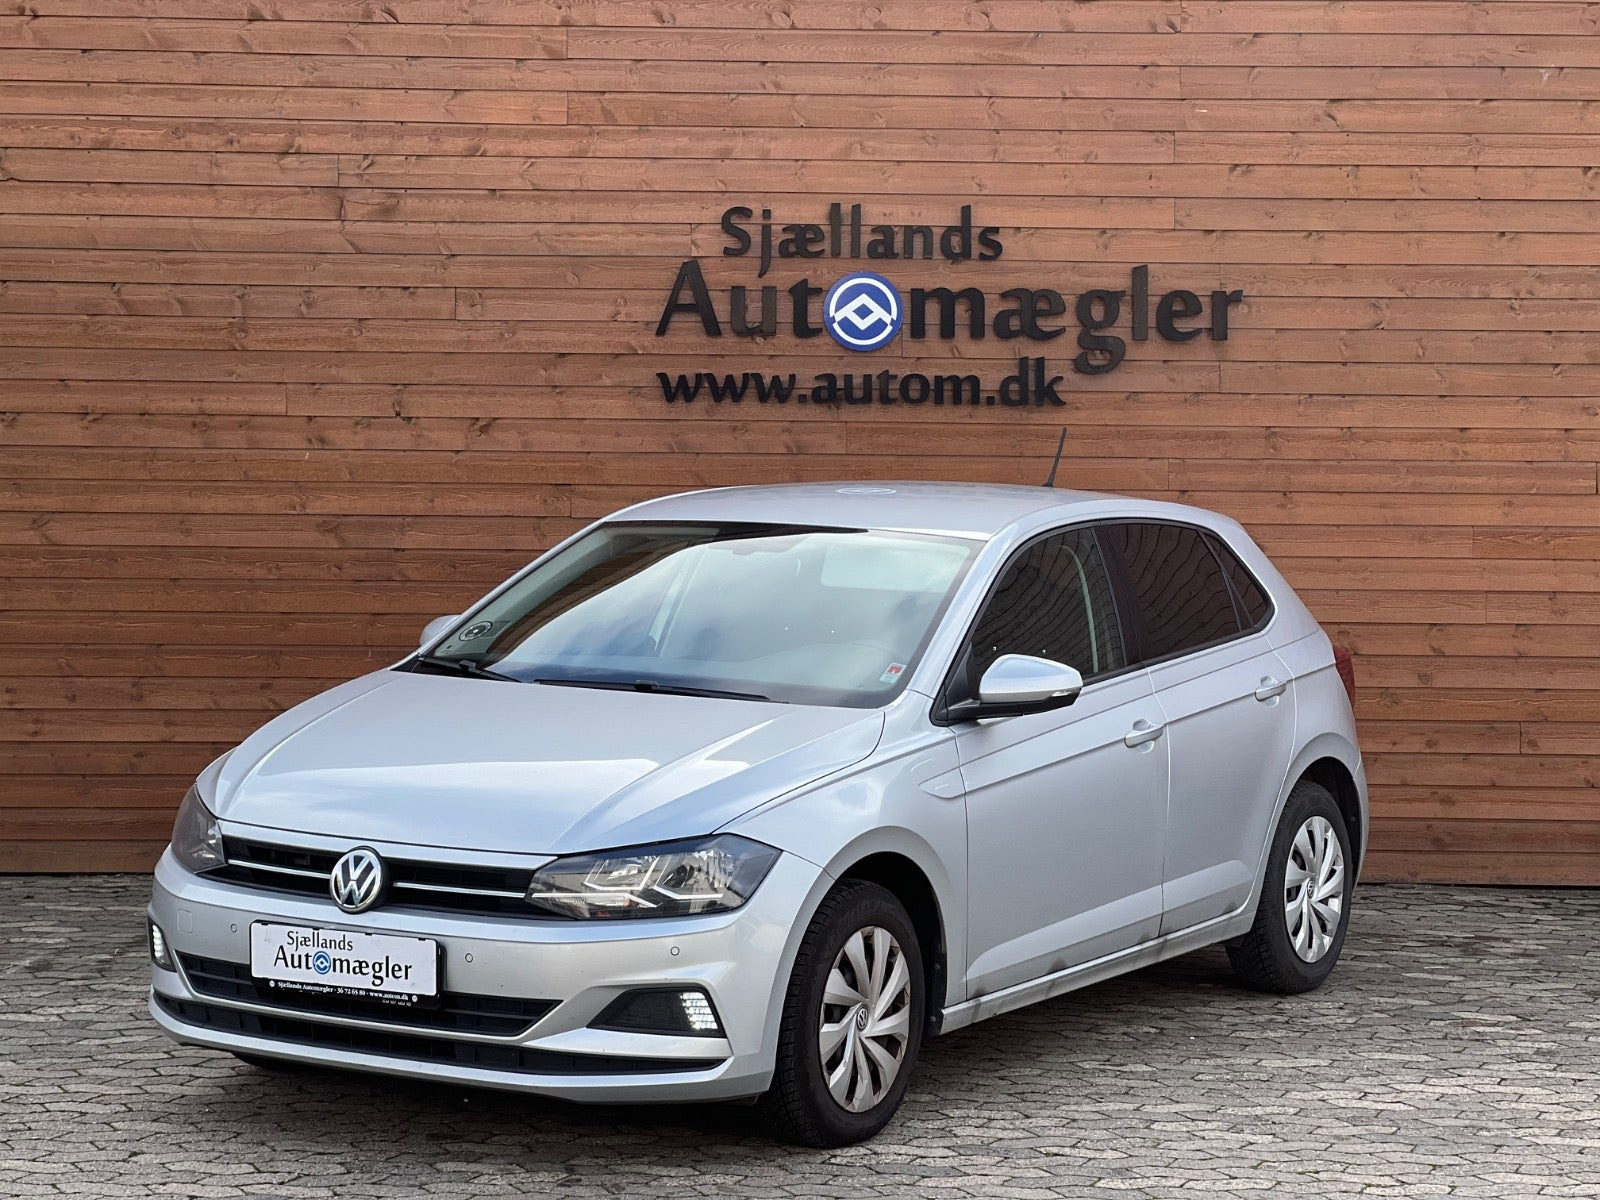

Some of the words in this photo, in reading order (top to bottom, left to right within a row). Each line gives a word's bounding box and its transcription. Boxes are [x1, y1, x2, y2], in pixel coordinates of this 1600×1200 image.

[721, 203, 1003, 278] Sjællands
[655, 260, 1244, 375] Automægler
[656, 356, 1066, 406] www.autom.dk
[331, 850, 381, 908] VW
[274, 945, 412, 986] Automægler
[287, 930, 353, 951] Sjællands
[370, 991, 409, 1000] www.autom.dk
